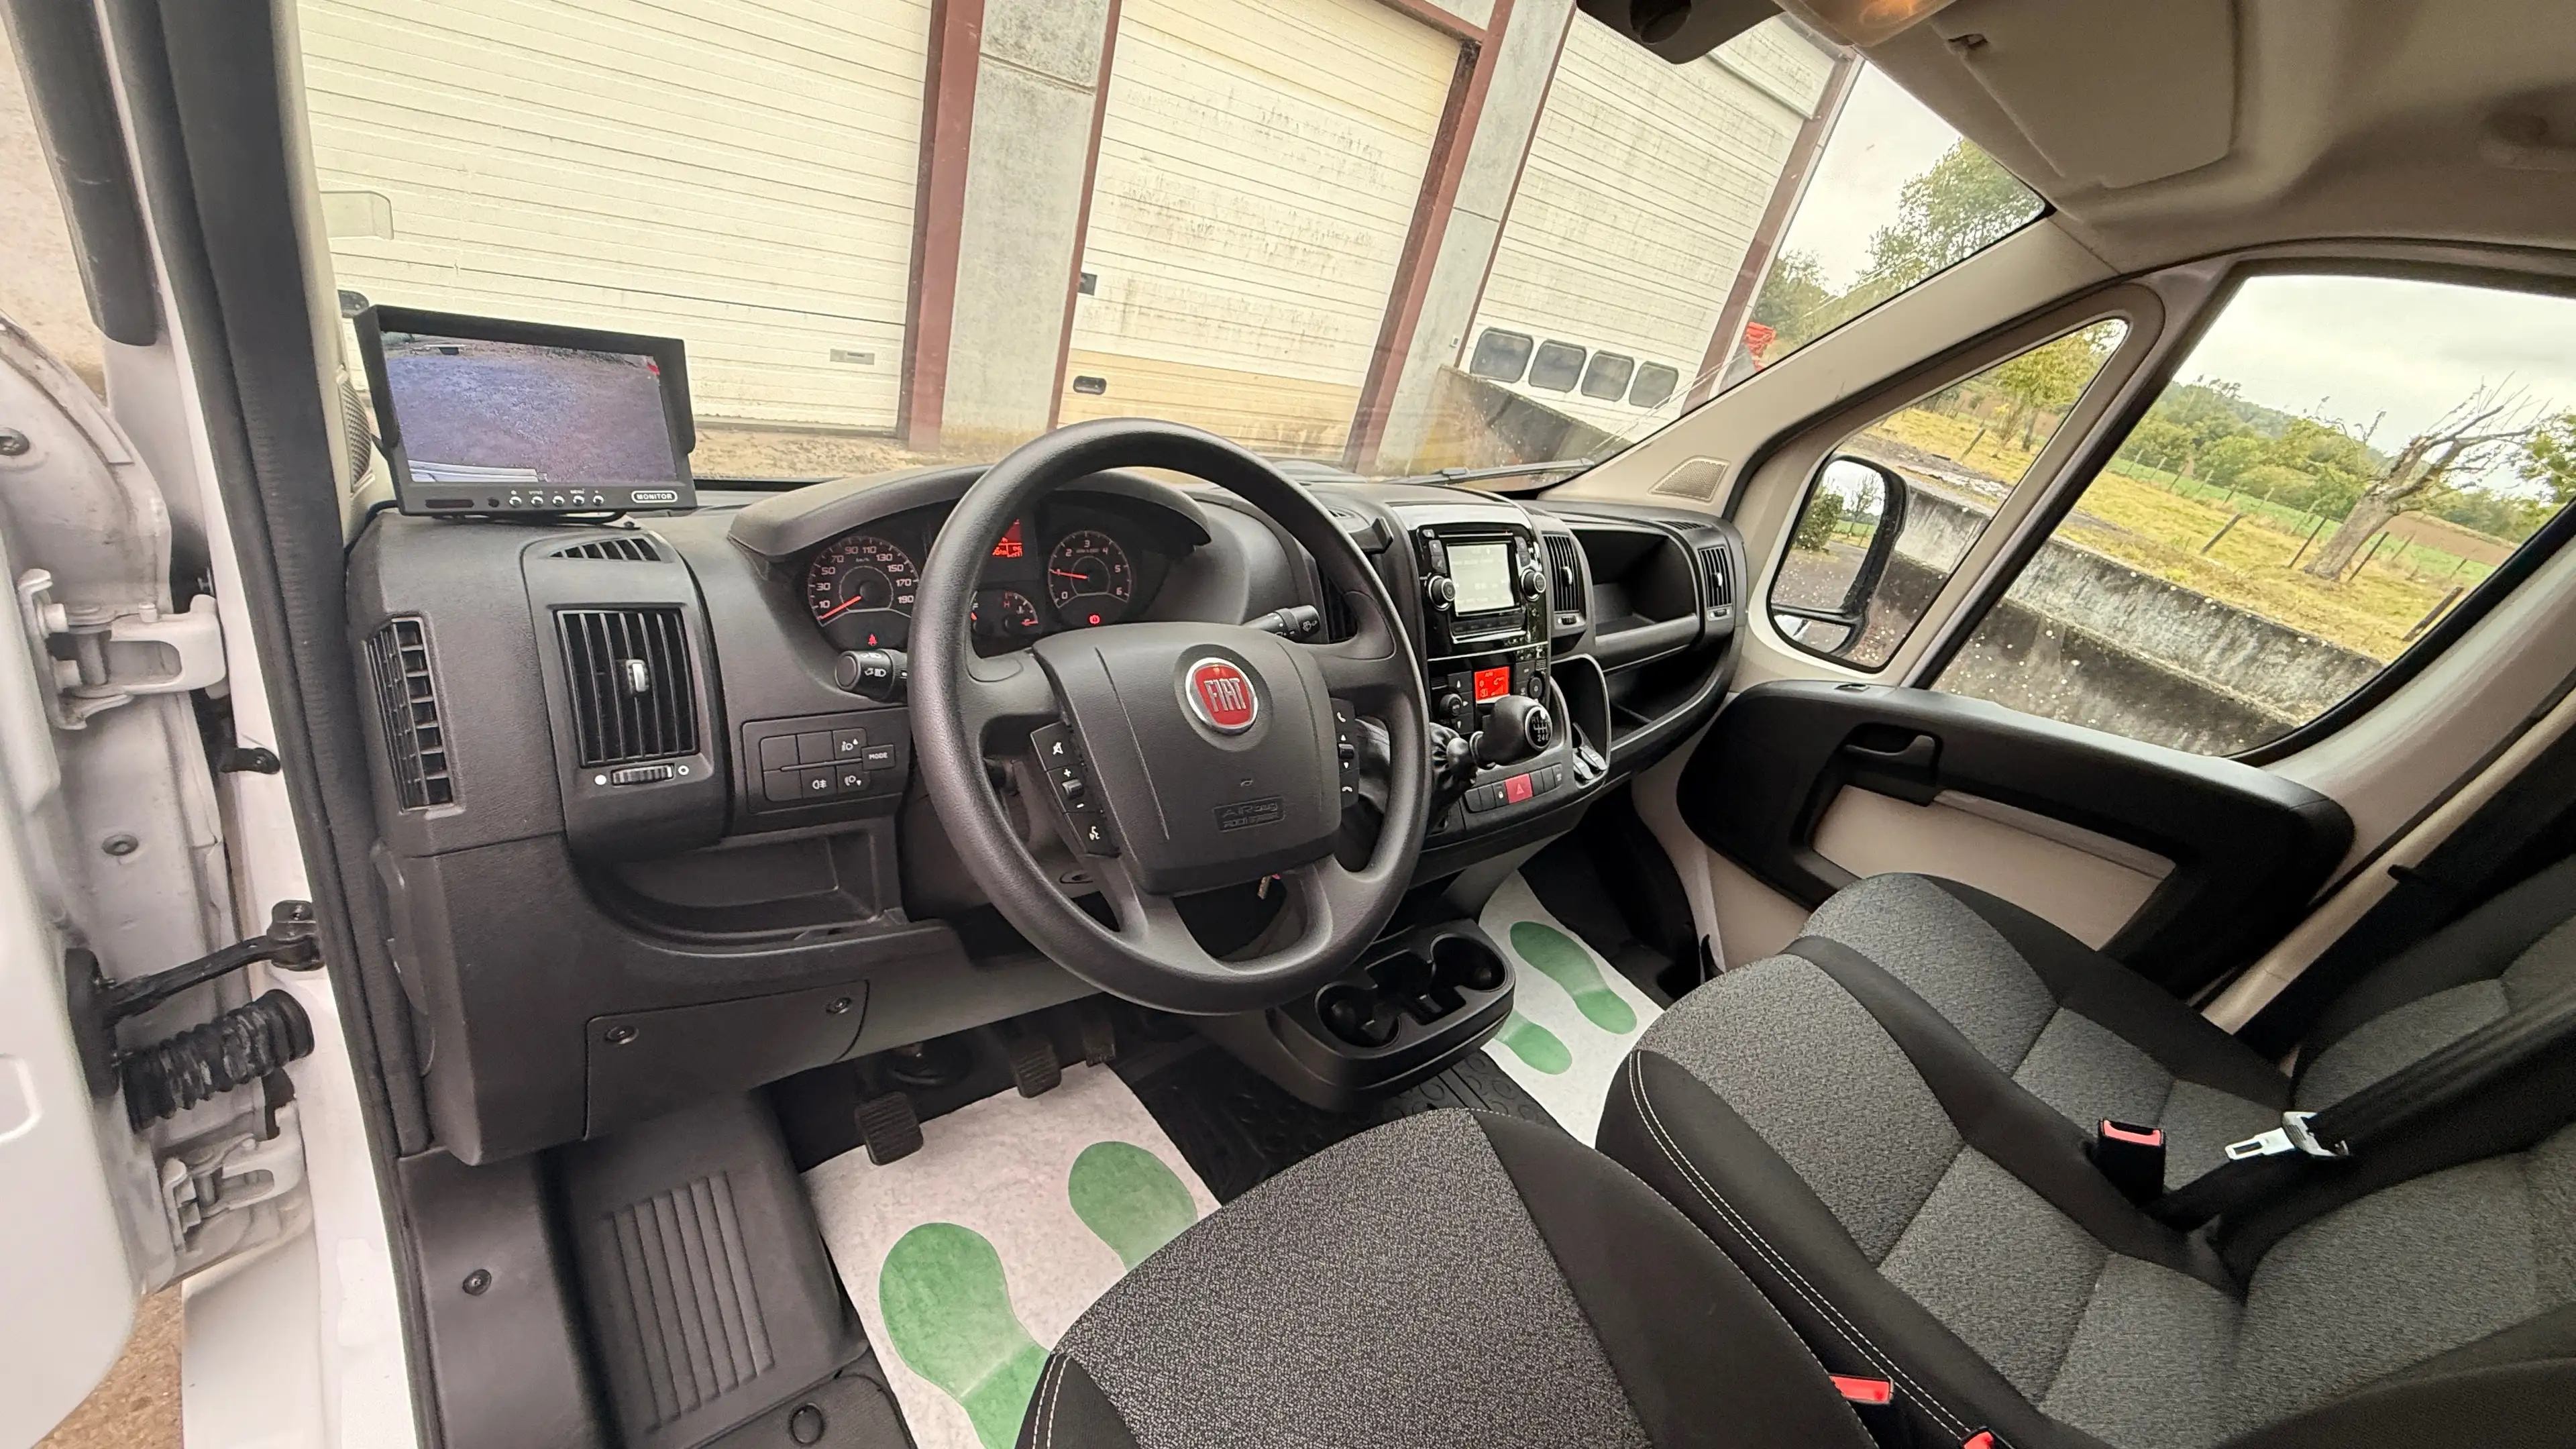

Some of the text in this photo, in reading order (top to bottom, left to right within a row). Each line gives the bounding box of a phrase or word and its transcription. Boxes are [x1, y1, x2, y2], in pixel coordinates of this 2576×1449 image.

[1084, 539, 1090, 547] 3
[845, 546, 859, 554] 90
[863, 545, 877, 554] 110
[1065, 548, 1072, 557] 2
[830, 555, 844, 563] 70
[875, 553, 893, 562] 130
[821, 567, 836, 575] 50
[887, 564, 904, 572] 150
[1114, 564, 1121, 573] 5
[816, 582, 830, 591] 30
[896, 579, 912, 587] 170
[1116, 587, 1122, 596] 6
[818, 600, 830, 608] 10
[897, 595, 914, 604] 190
[1203, 678, 1246, 712] FIAT
